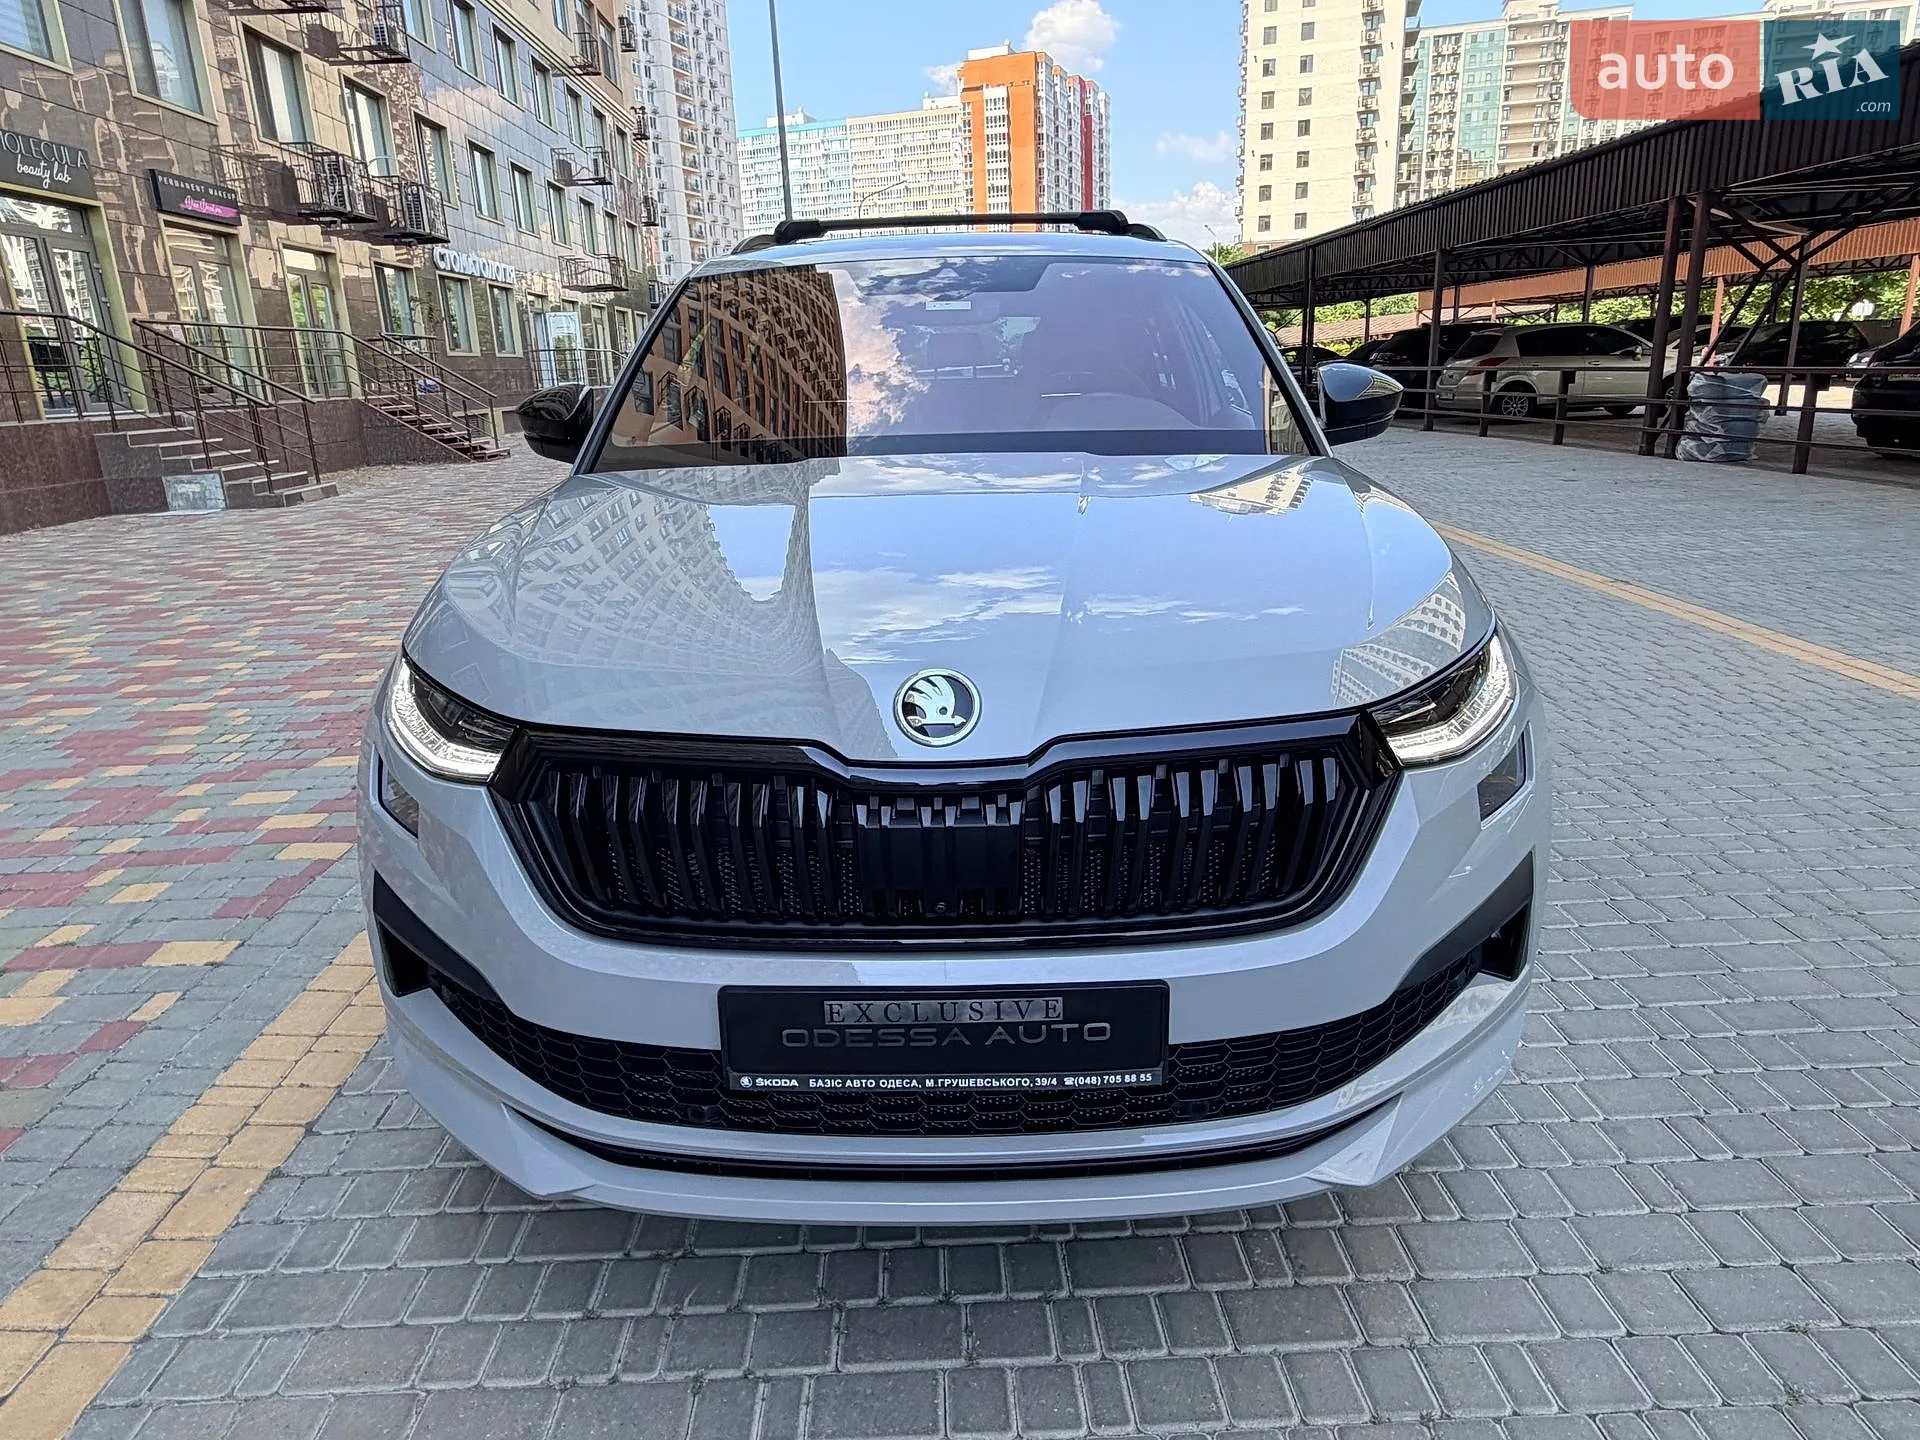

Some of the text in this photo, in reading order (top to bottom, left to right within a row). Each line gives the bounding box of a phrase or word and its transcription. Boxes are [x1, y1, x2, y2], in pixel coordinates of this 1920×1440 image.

[16, 153, 72, 189] beauty lab
[826, 998, 1062, 1024] EXCLUSIVE
[781, 1022, 1111, 1048] ODESSA AUTO
[809, 1079, 842, 1088] БАЗІС
[845, 1079, 876, 1088] АВТО
[879, 1079, 922, 1089] ОДЕСА,
[1035, 1077, 1058, 1087] 39/4
[1103, 1075, 1122, 1084] 705
[1124, 1074, 1137, 1083] 88
[1139, 1073, 1153, 1082] 55
